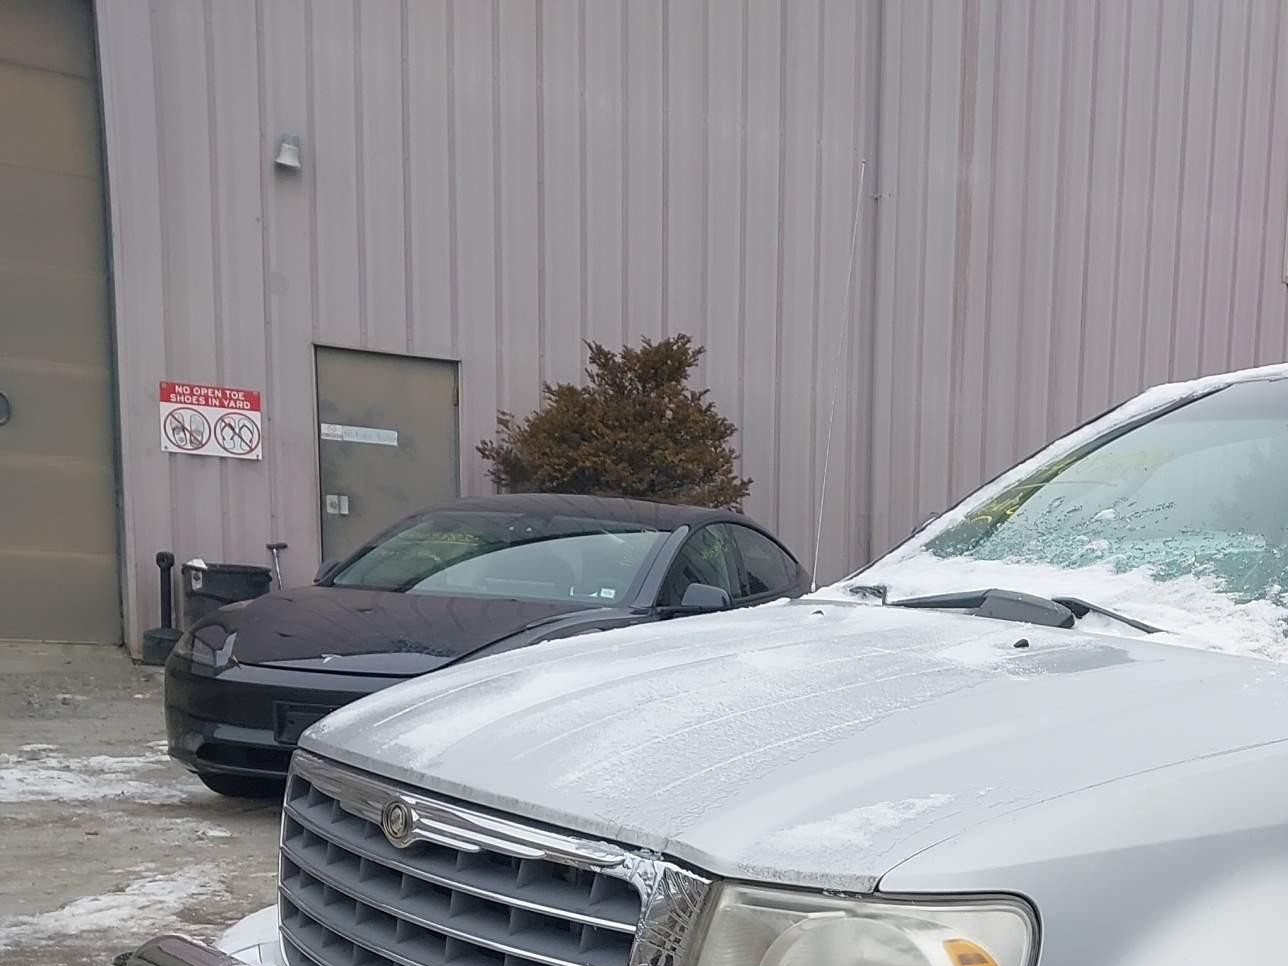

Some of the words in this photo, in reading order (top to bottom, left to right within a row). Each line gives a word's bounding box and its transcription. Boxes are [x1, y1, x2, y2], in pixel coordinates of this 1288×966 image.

[175, 385, 190, 394] NO
[193, 387, 222, 397] OPEN
[225, 390, 245, 400] TOE
[170, 393, 205, 404] SHOES
[208, 398, 220, 406] IN
[223, 399, 251, 409] YARD
